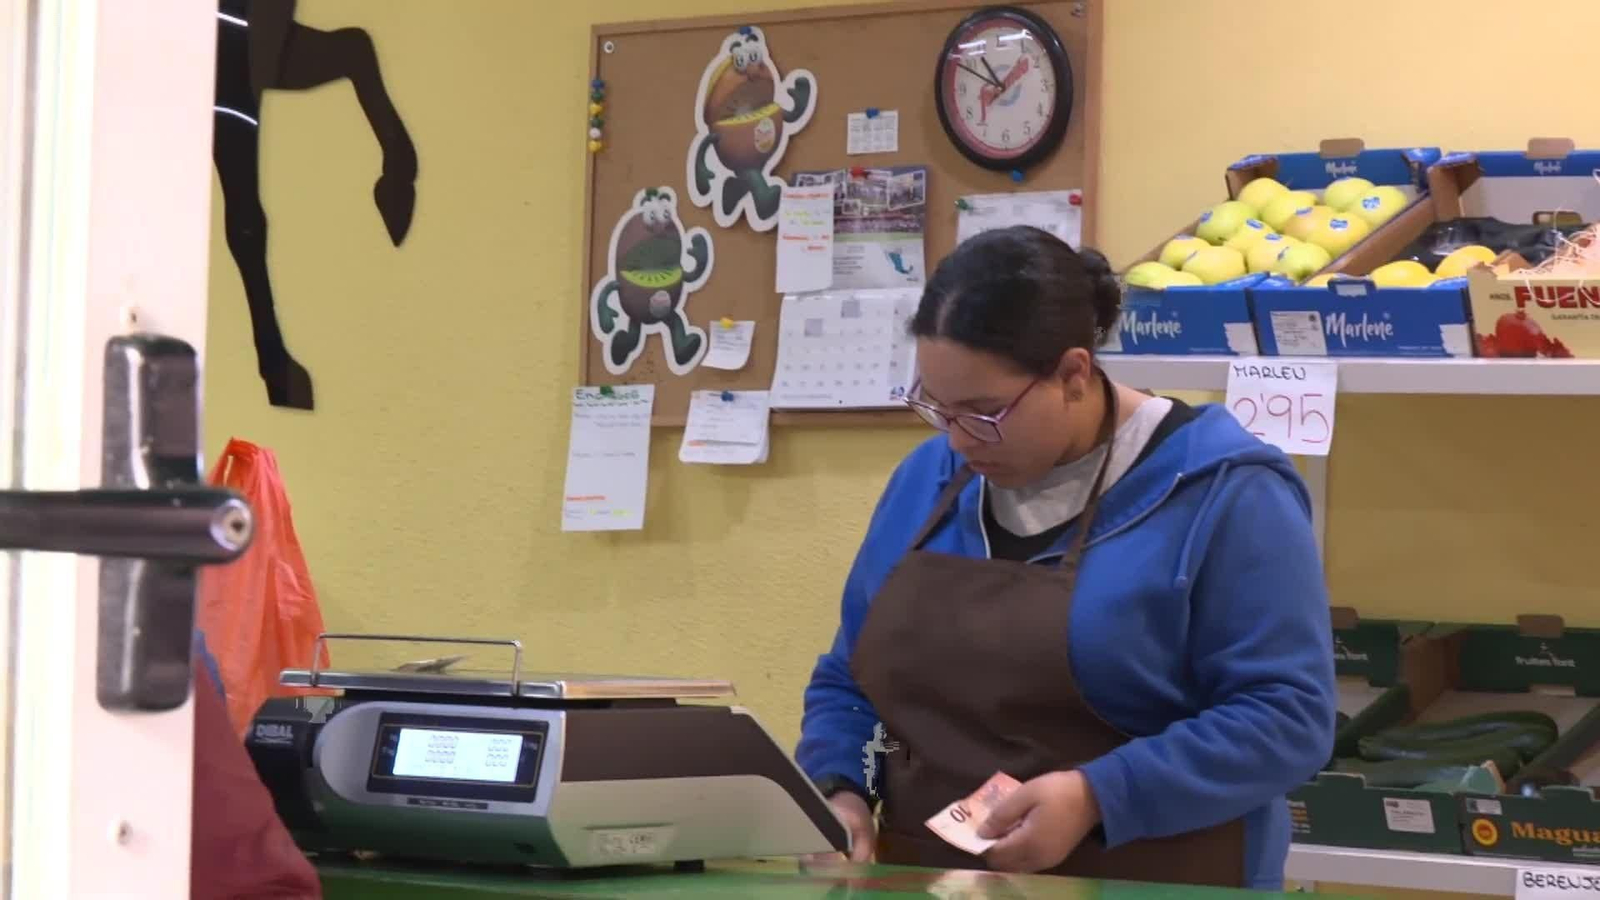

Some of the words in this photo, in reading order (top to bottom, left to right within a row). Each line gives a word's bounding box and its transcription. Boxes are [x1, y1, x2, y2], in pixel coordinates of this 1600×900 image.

[1041, 78, 1049, 92] 3
[1037, 102, 1044, 117] 4
[1024, 121, 1032, 135] 5
[1002, 129, 1010, 143] 6
[1119, 310, 1183, 346] Marlene
[1325, 312, 1394, 348] Marlene
[950, 804, 972, 823] 10
